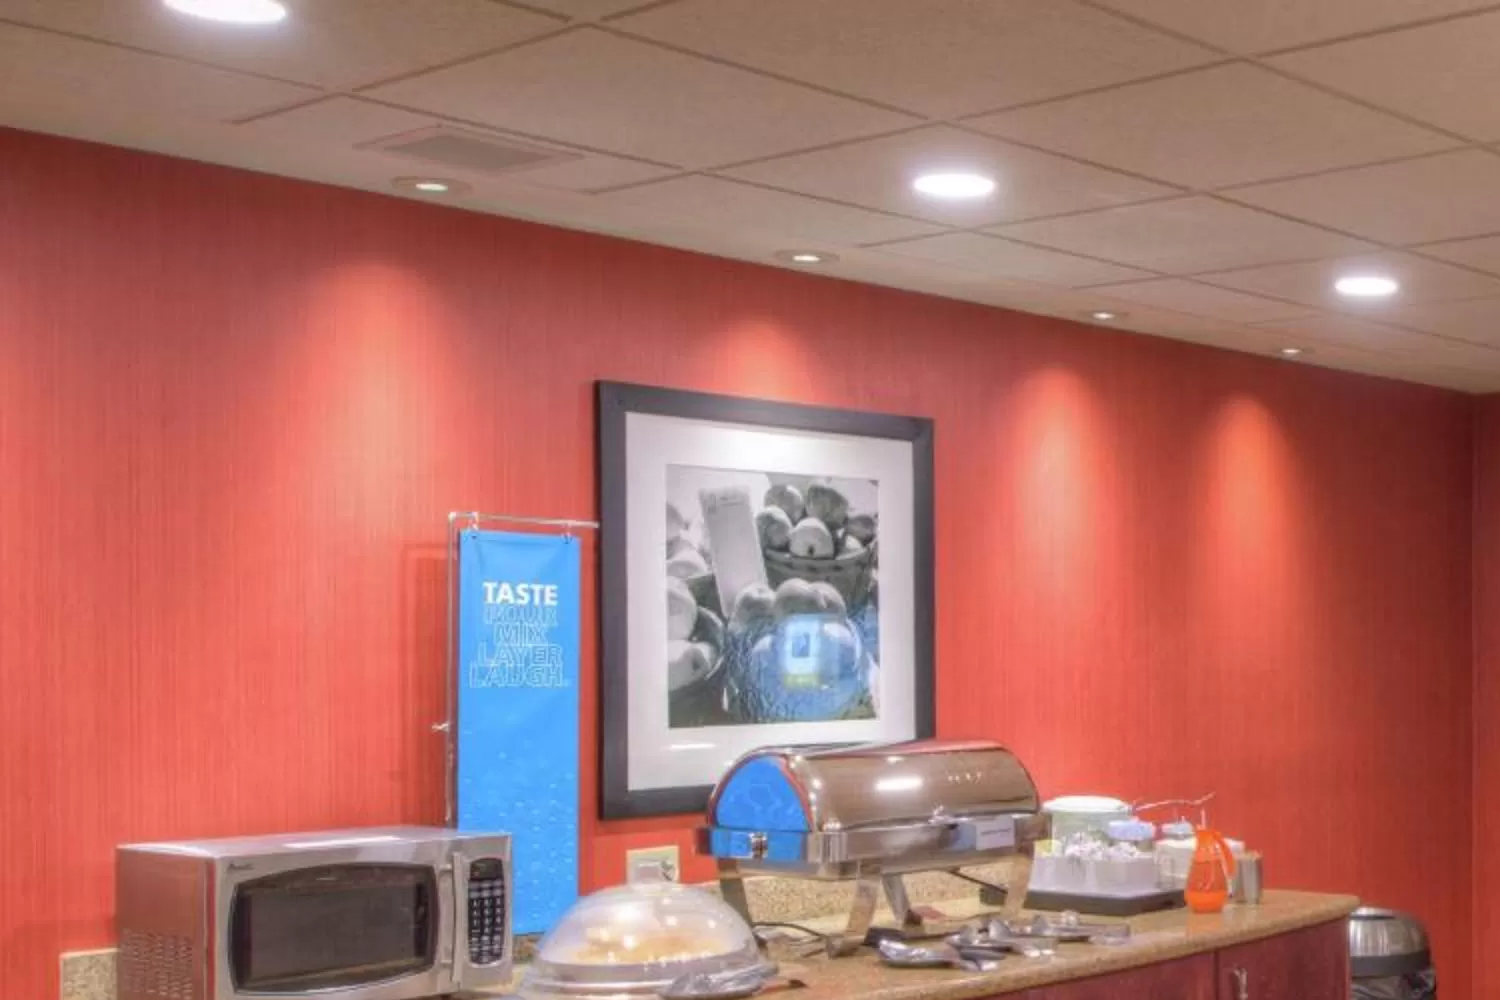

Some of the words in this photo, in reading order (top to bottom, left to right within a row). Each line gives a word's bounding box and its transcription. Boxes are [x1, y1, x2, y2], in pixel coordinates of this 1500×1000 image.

[483, 581, 558, 606] TASTE
[485, 605, 558, 627] POUR
[493, 621, 549, 647] MIX
[477, 642, 563, 667] LAYER
